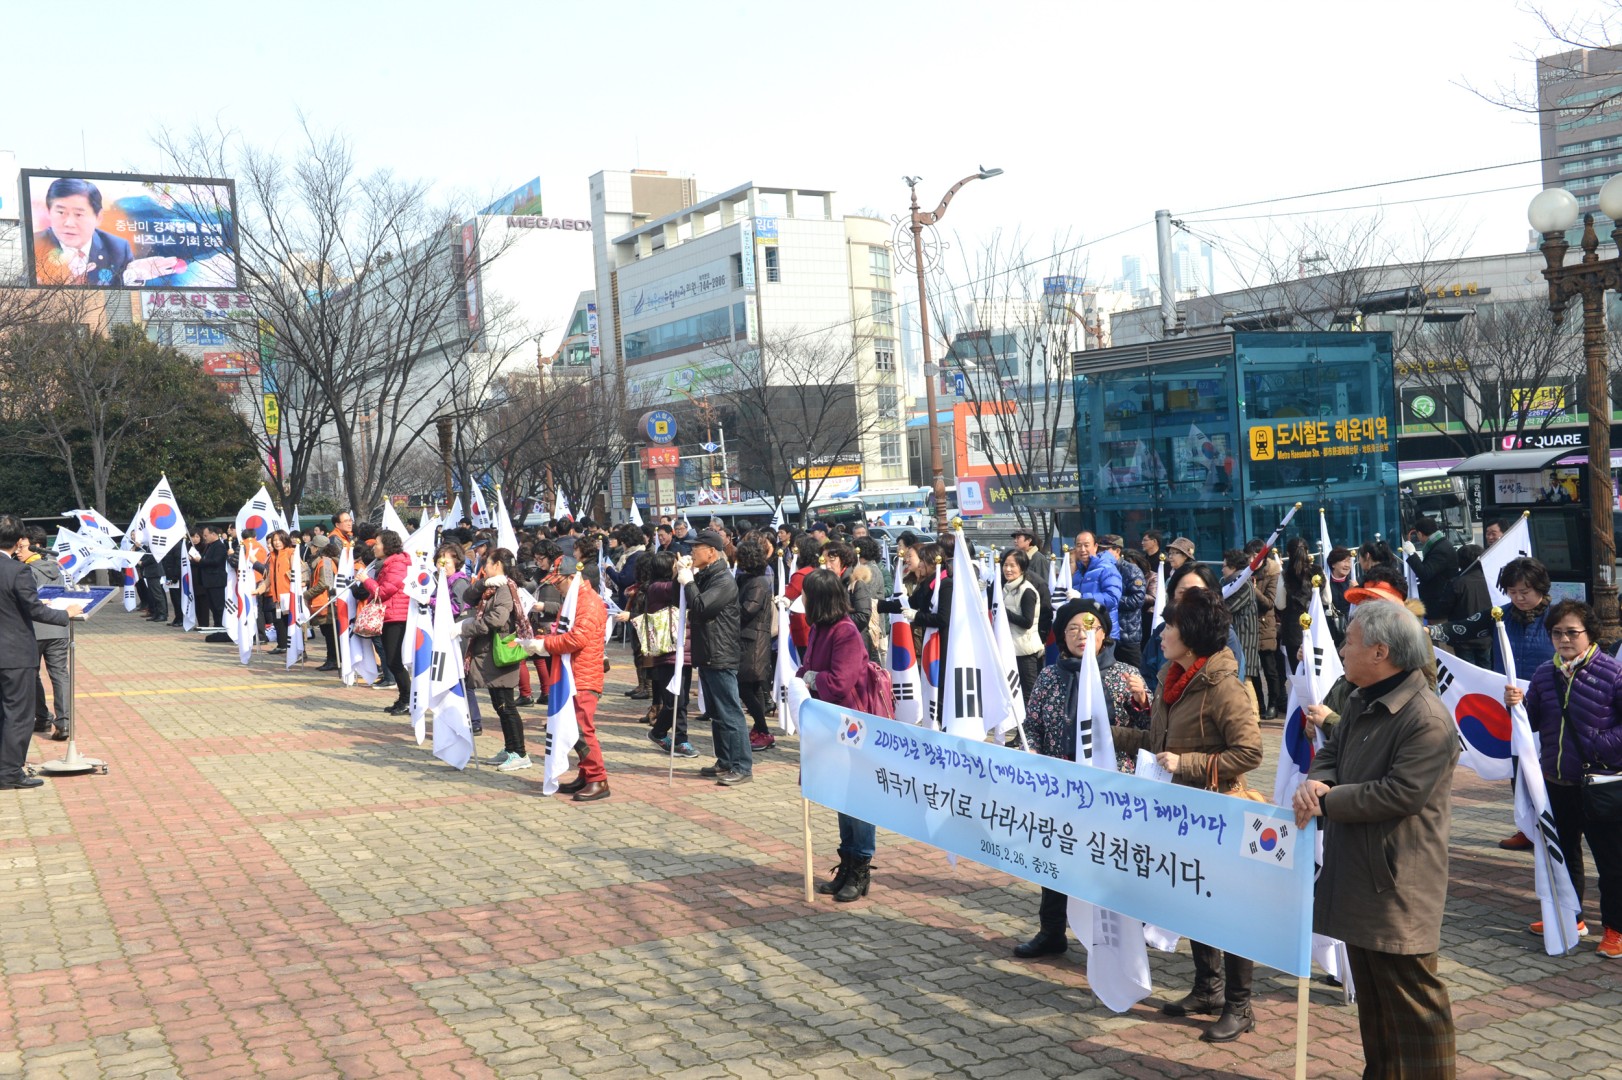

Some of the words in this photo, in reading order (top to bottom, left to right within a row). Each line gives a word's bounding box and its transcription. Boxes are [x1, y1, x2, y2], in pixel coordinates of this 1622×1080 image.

[115, 220, 149, 232] 중남미
[755, 218, 777, 231] 임대
[133, 234, 176, 246] 비즈니스
[180, 235, 200, 247] 기회
[1276, 420, 1330, 446] 도시철도
[1334, 416, 1388, 443] 해운대역
[654, 434, 672, 443] METRO
[1277, 450, 1290, 460] Metro
[1290, 449, 1312, 459] Haeundae
[874, 729, 920, 760] 2015년은
[922, 742, 986, 779] 광복70주년
[1100, 790, 1148, 822] 기념의
[1154, 799, 1227, 845] 해입니다
[875, 767, 919, 804] 태극기
[922, 782, 973, 819] 달기로
[980, 799, 1078, 856] 나라사랑을
[1086, 831, 1212, 898] 실천합시다.
[980, 839, 1028, 870] 2015.2.26.
[1031, 856, 1060, 880] 중2동
